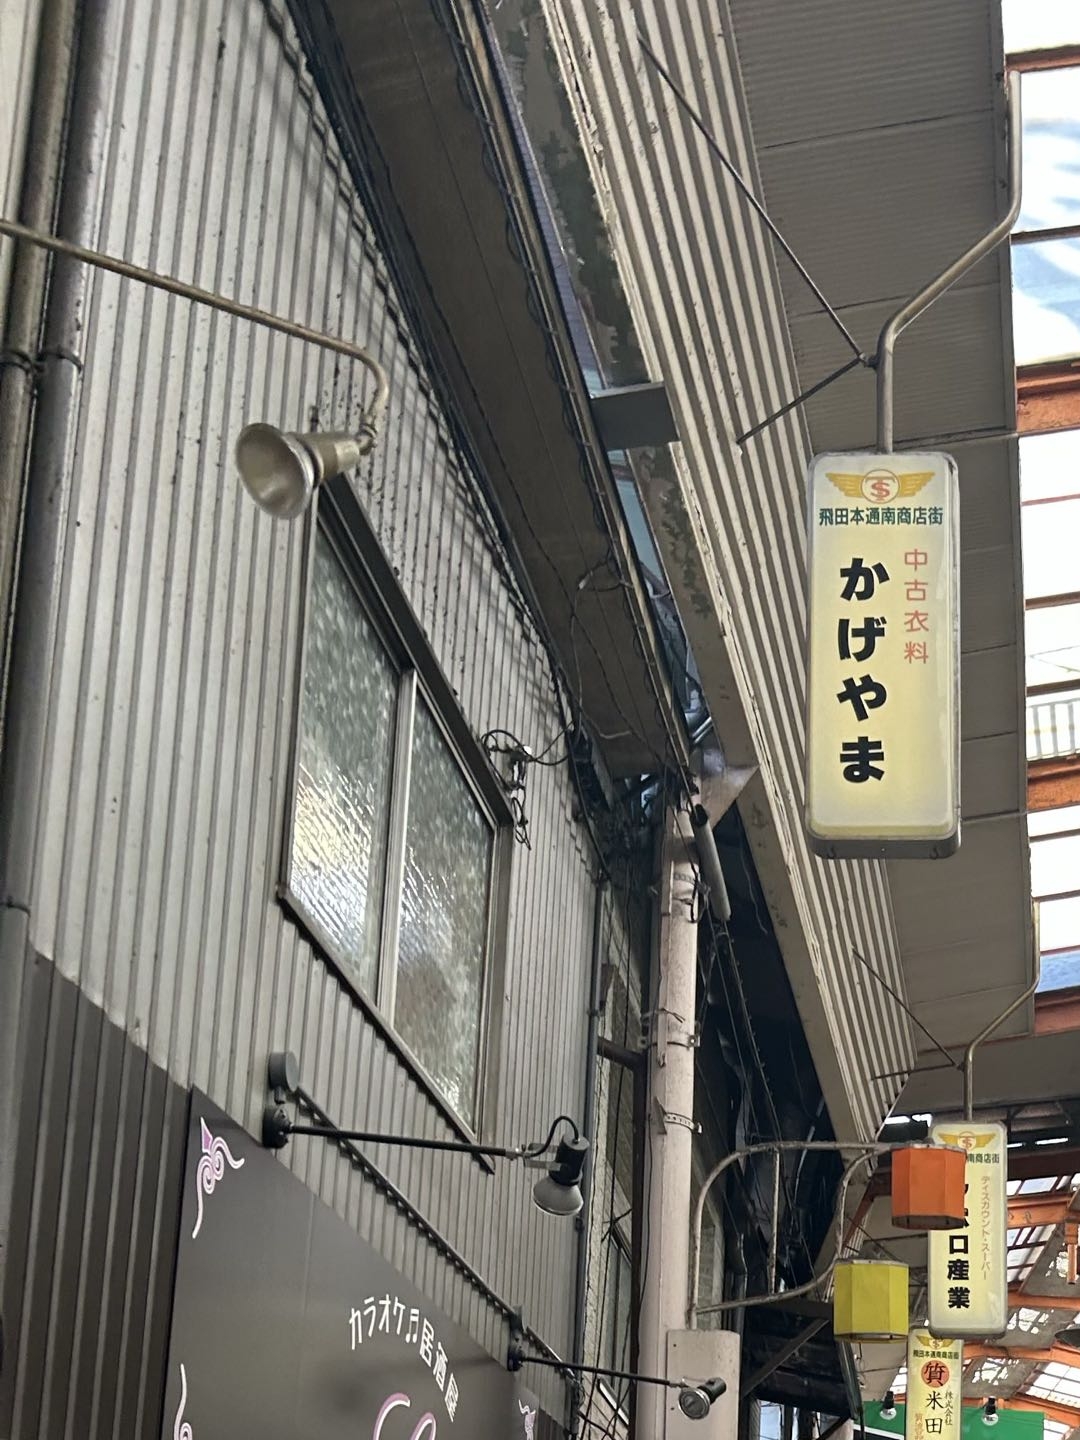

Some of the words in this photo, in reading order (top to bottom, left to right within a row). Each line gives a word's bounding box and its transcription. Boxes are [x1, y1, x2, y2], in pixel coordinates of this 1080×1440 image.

[818, 506, 944, 526] 飛田本通南商店街
[903, 547, 930, 665] 中古衣料
[836, 556, 890, 784] かげやま
[947, 1183, 971, 1309] 口産業
[349, 1293, 406, 1351] カラオケ
[418, 1317, 460, 1422] 居酒屋
[923, 1361, 946, 1387] 質
